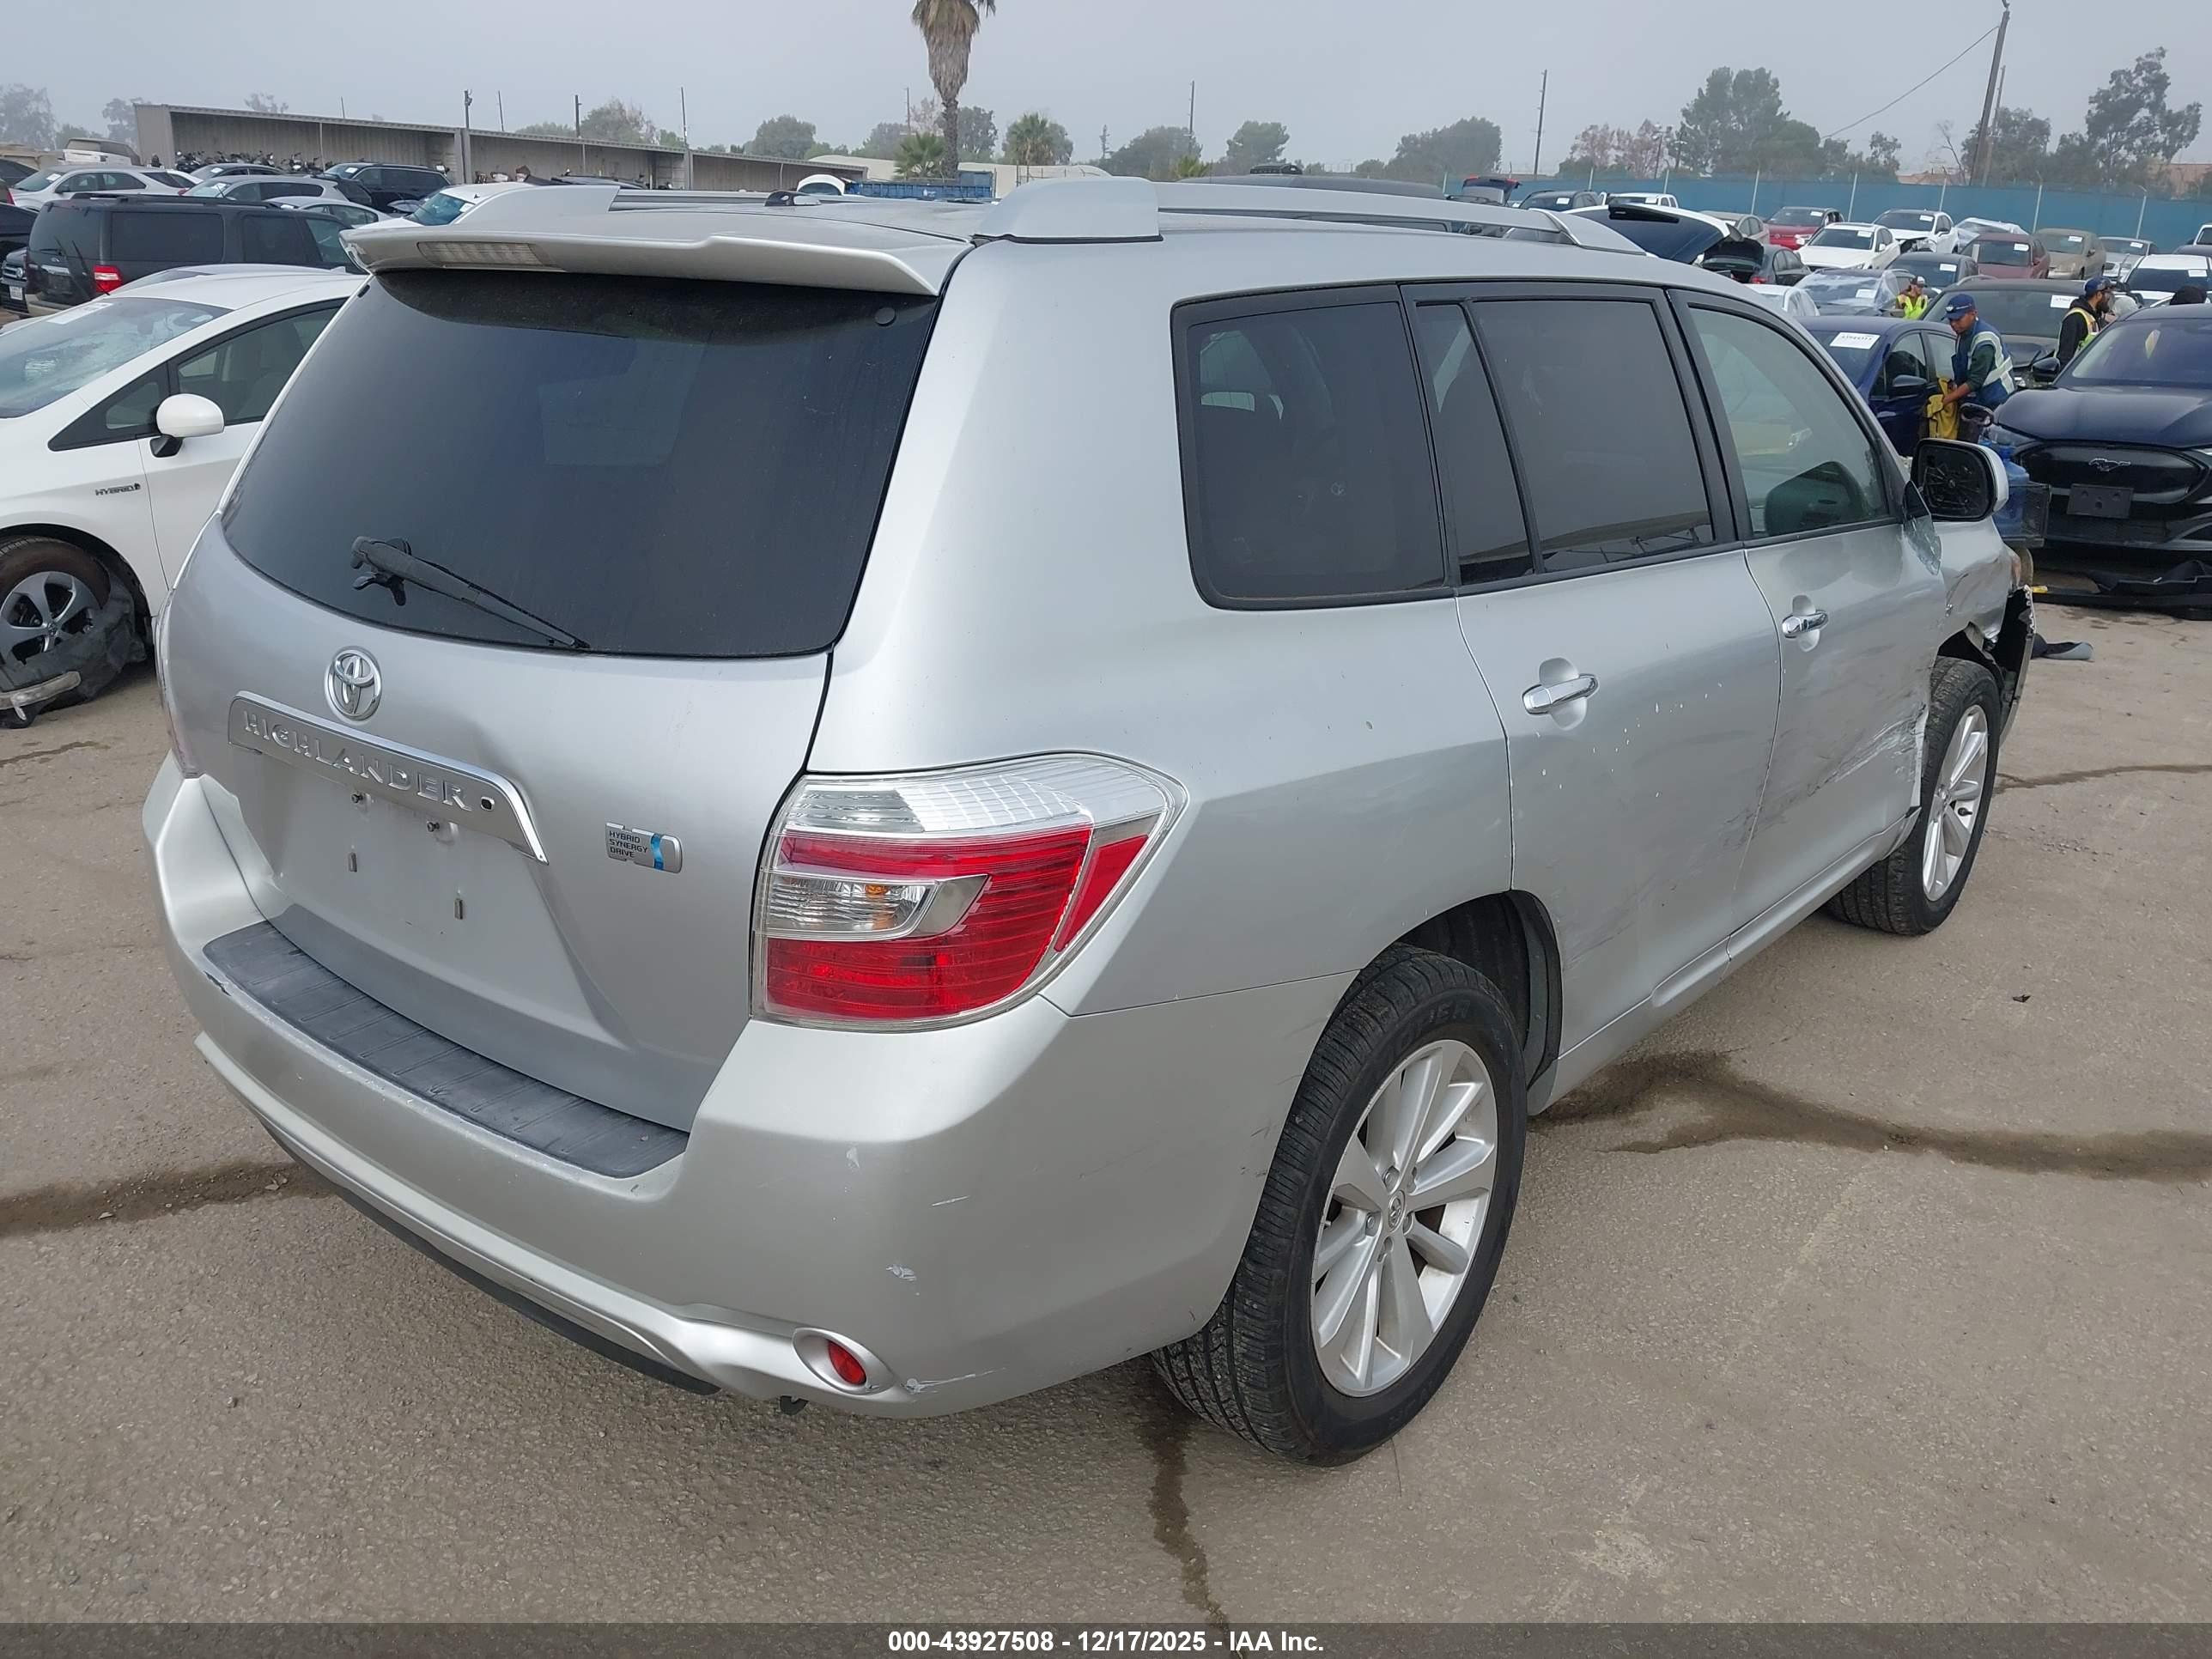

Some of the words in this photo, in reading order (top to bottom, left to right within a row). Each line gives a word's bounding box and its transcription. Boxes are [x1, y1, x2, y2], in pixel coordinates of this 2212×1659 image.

[243, 710, 472, 811] HIGHLANDER
[609, 830, 641, 844] HYBRID
[609, 839, 648, 854] SYNERGY
[610, 847, 635, 859] DRIVE
